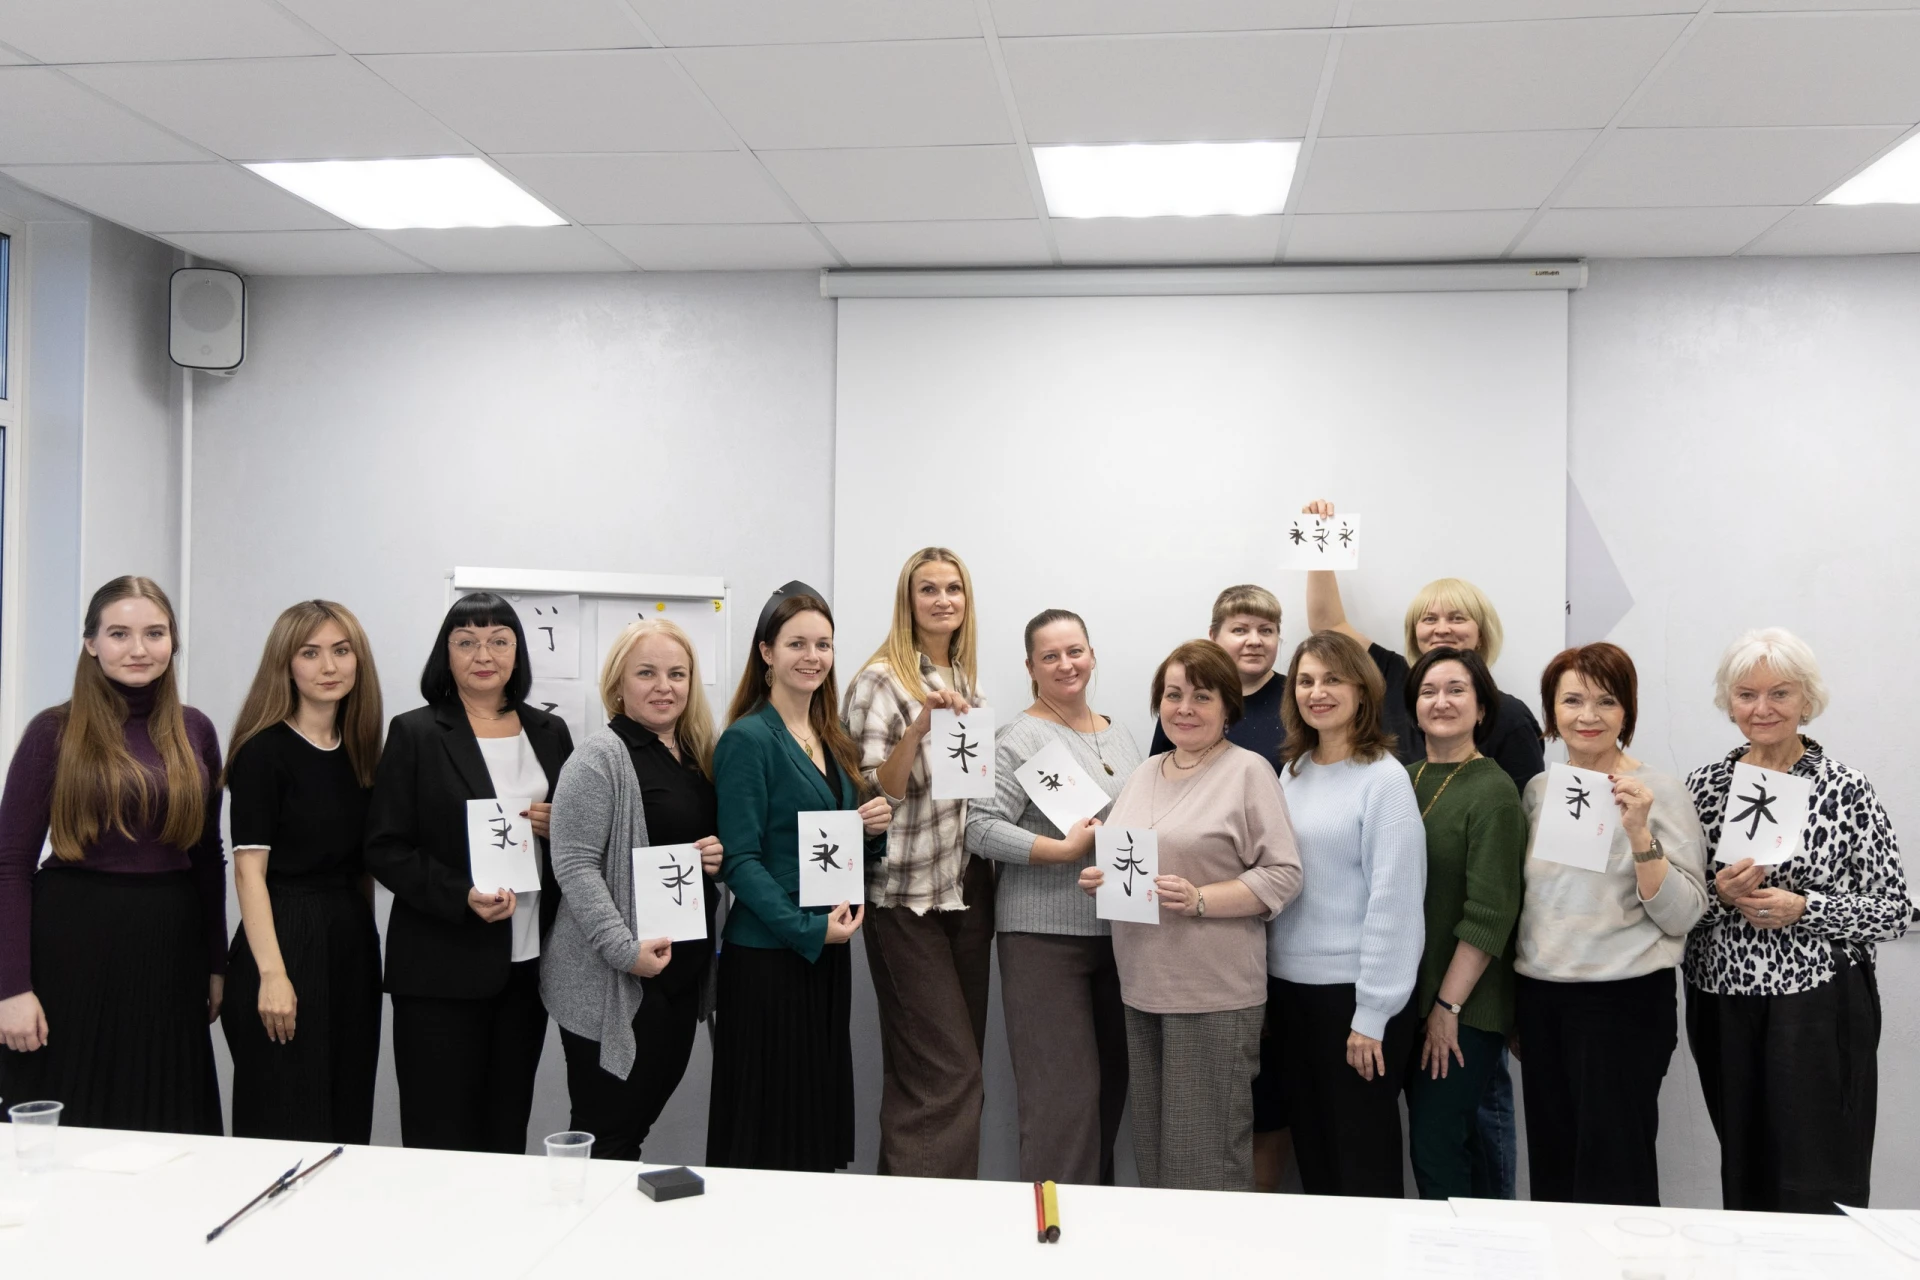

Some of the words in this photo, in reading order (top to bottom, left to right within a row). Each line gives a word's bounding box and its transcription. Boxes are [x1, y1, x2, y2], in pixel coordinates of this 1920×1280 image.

[947, 721, 979, 774] 永
[1565, 775, 1591, 820] 永
[808, 828, 843, 873] 永
[658, 852, 695, 906] 永
